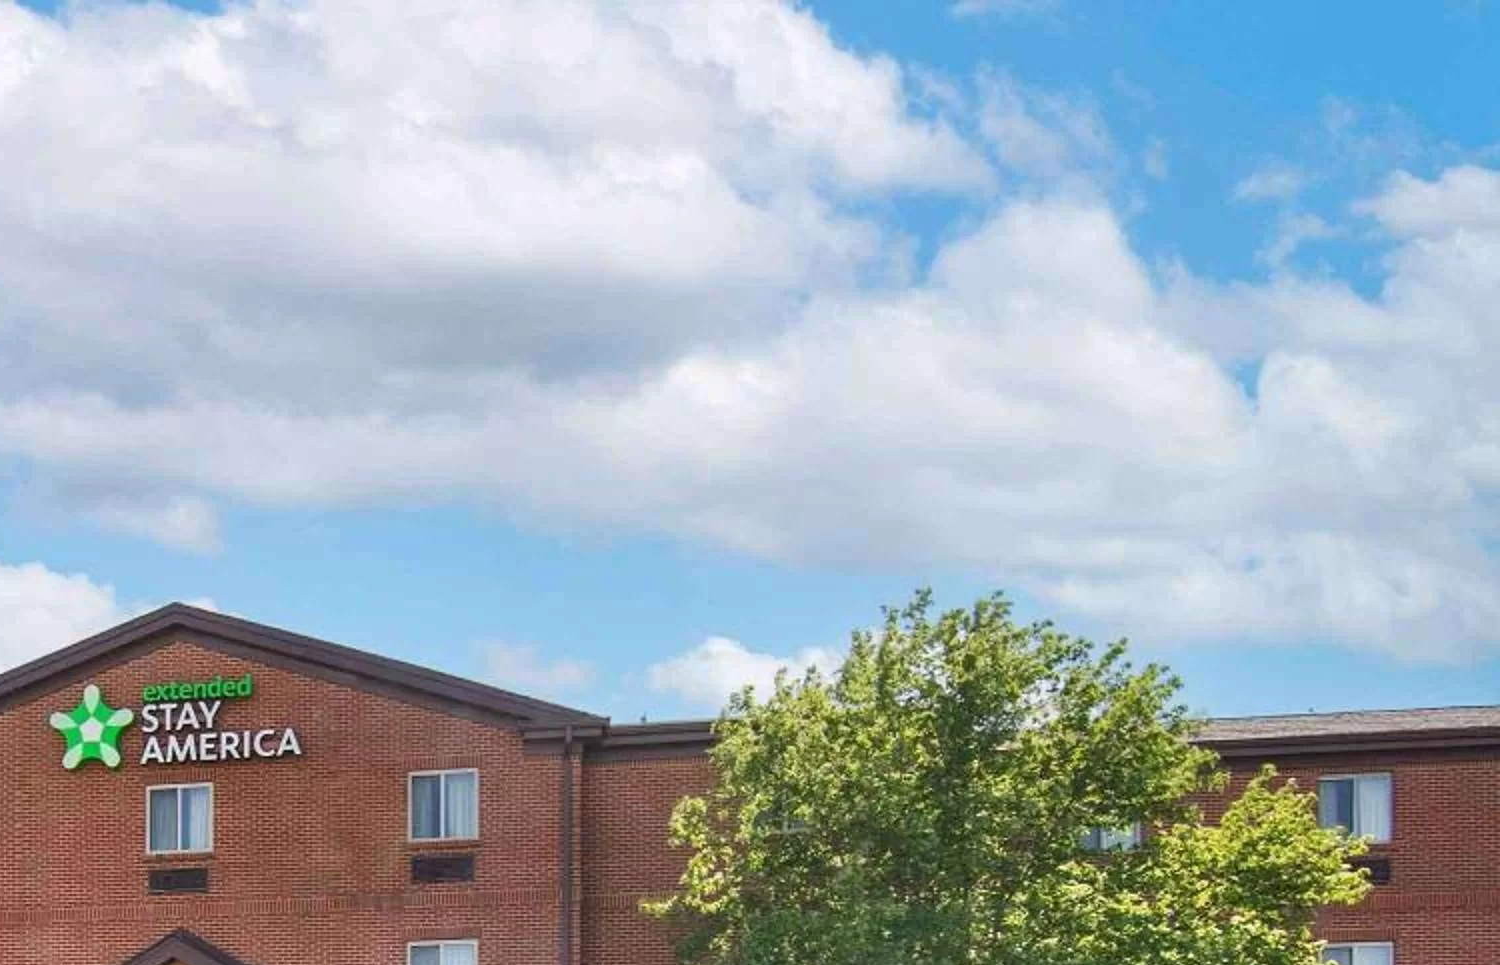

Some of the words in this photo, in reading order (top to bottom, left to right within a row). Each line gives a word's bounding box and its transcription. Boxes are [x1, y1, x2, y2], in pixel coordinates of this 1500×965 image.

[143, 674, 253, 701] extended
[141, 700, 221, 733] STAY
[139, 727, 302, 765] AMERICA
